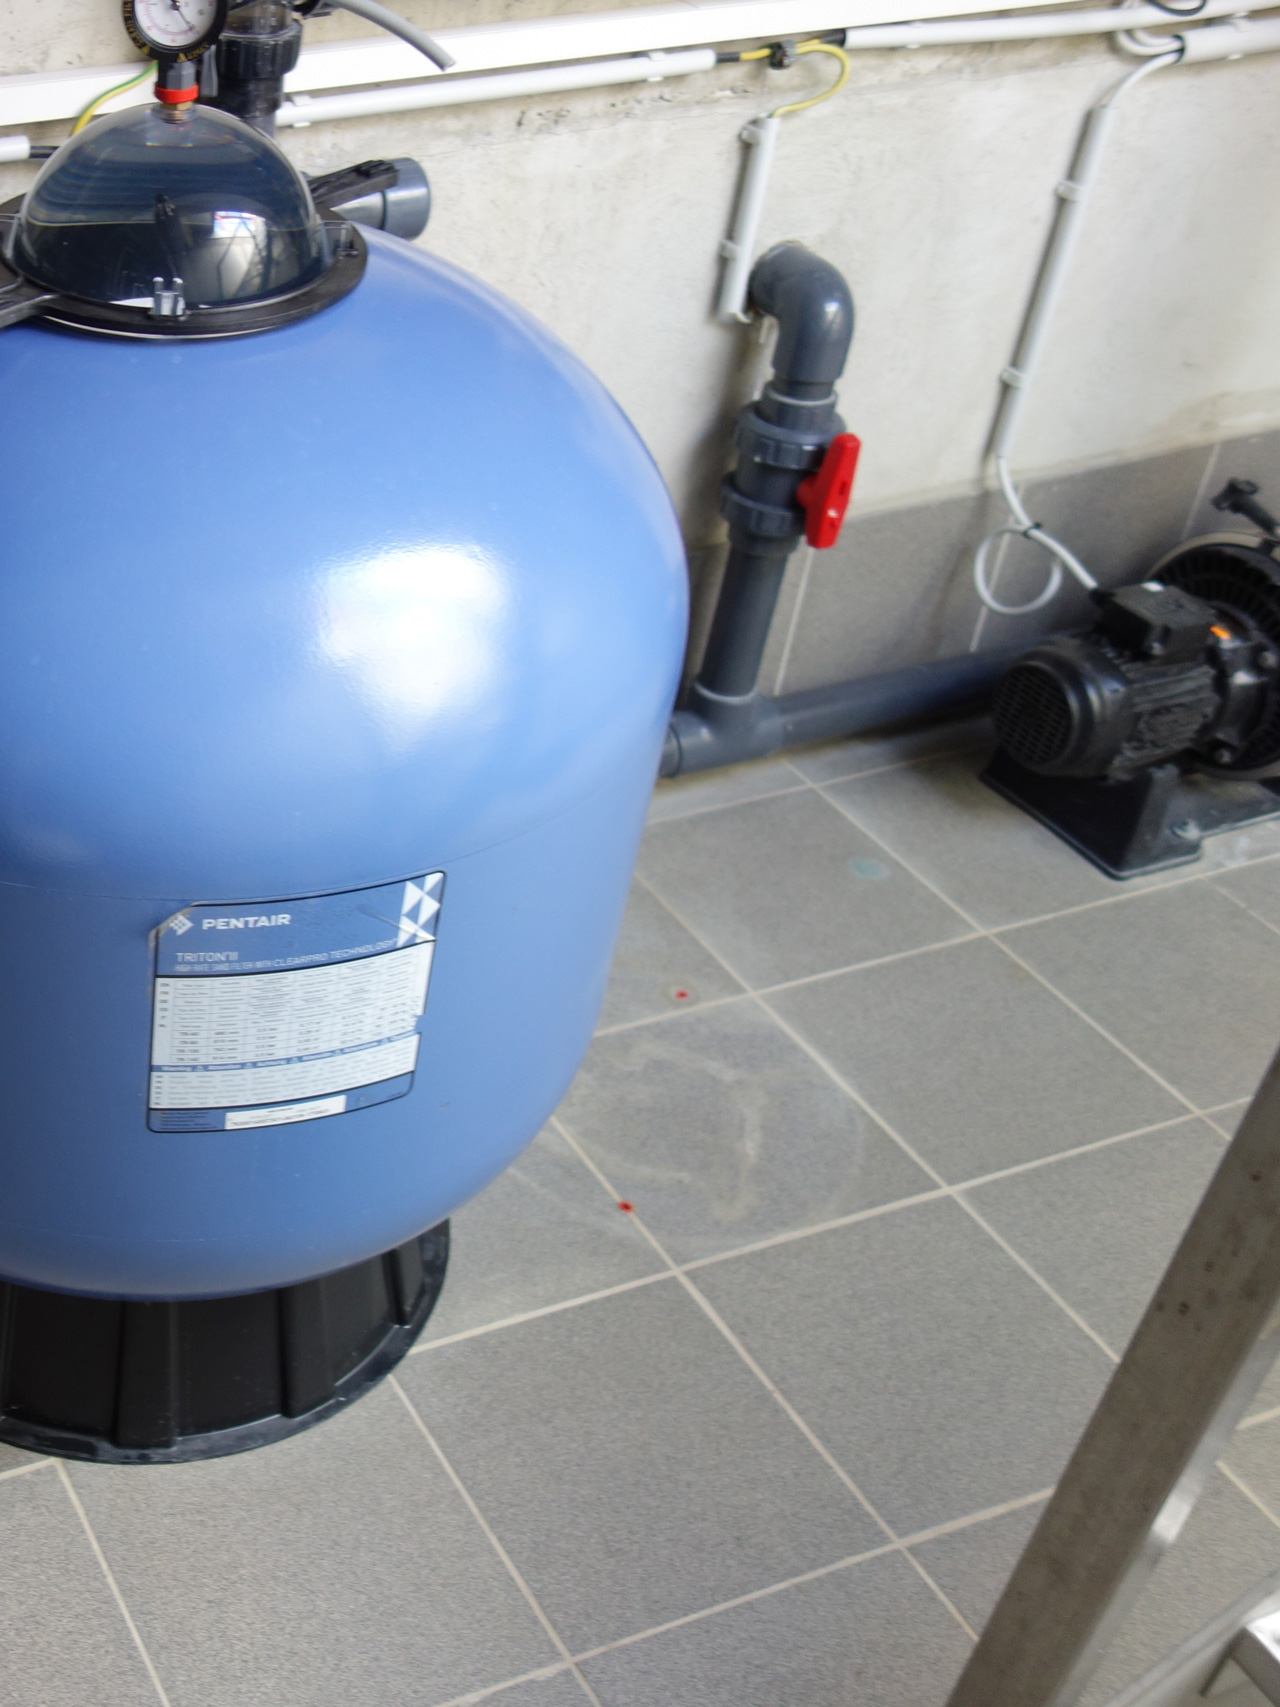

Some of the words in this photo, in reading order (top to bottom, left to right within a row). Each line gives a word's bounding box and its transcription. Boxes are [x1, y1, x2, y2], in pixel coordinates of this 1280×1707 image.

[201, 914, 292, 930] PENTAIR
[231, 961, 254, 970] FILTER
[272, 953, 329, 967] CLEARPRO
